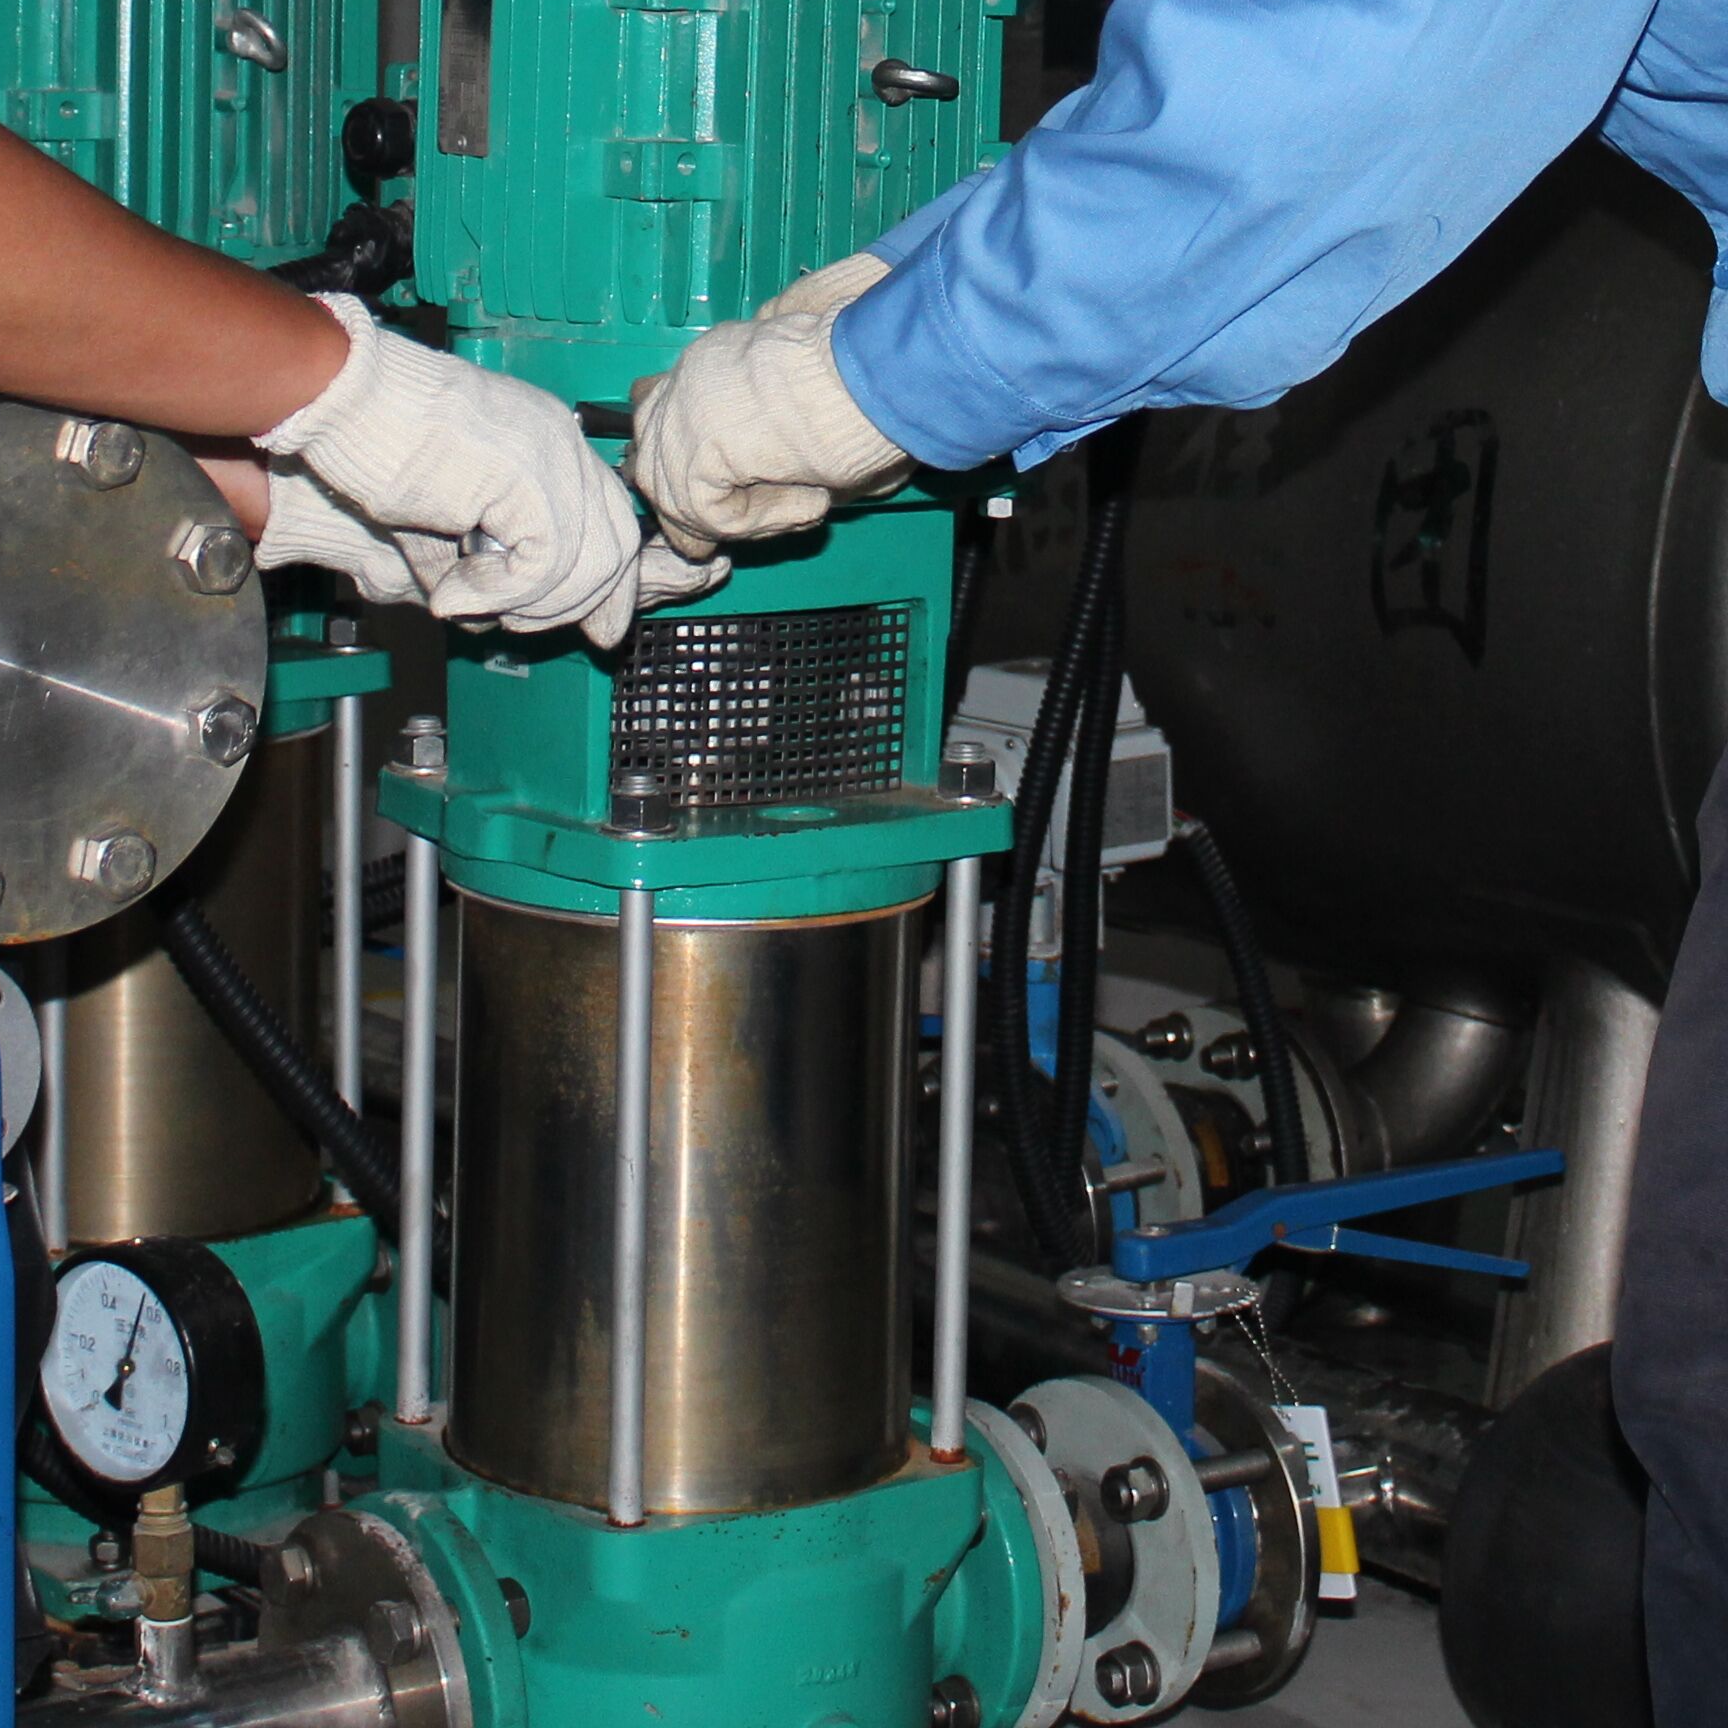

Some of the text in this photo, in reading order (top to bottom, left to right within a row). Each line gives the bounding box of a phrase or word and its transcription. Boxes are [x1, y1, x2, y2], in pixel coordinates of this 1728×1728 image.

[101, 1292, 117, 1311] 0.4
[146, 1306, 162, 1325] 0.6
[79, 1334, 96, 1353] 0.2
[166, 1359, 182, 1377] 0.8
